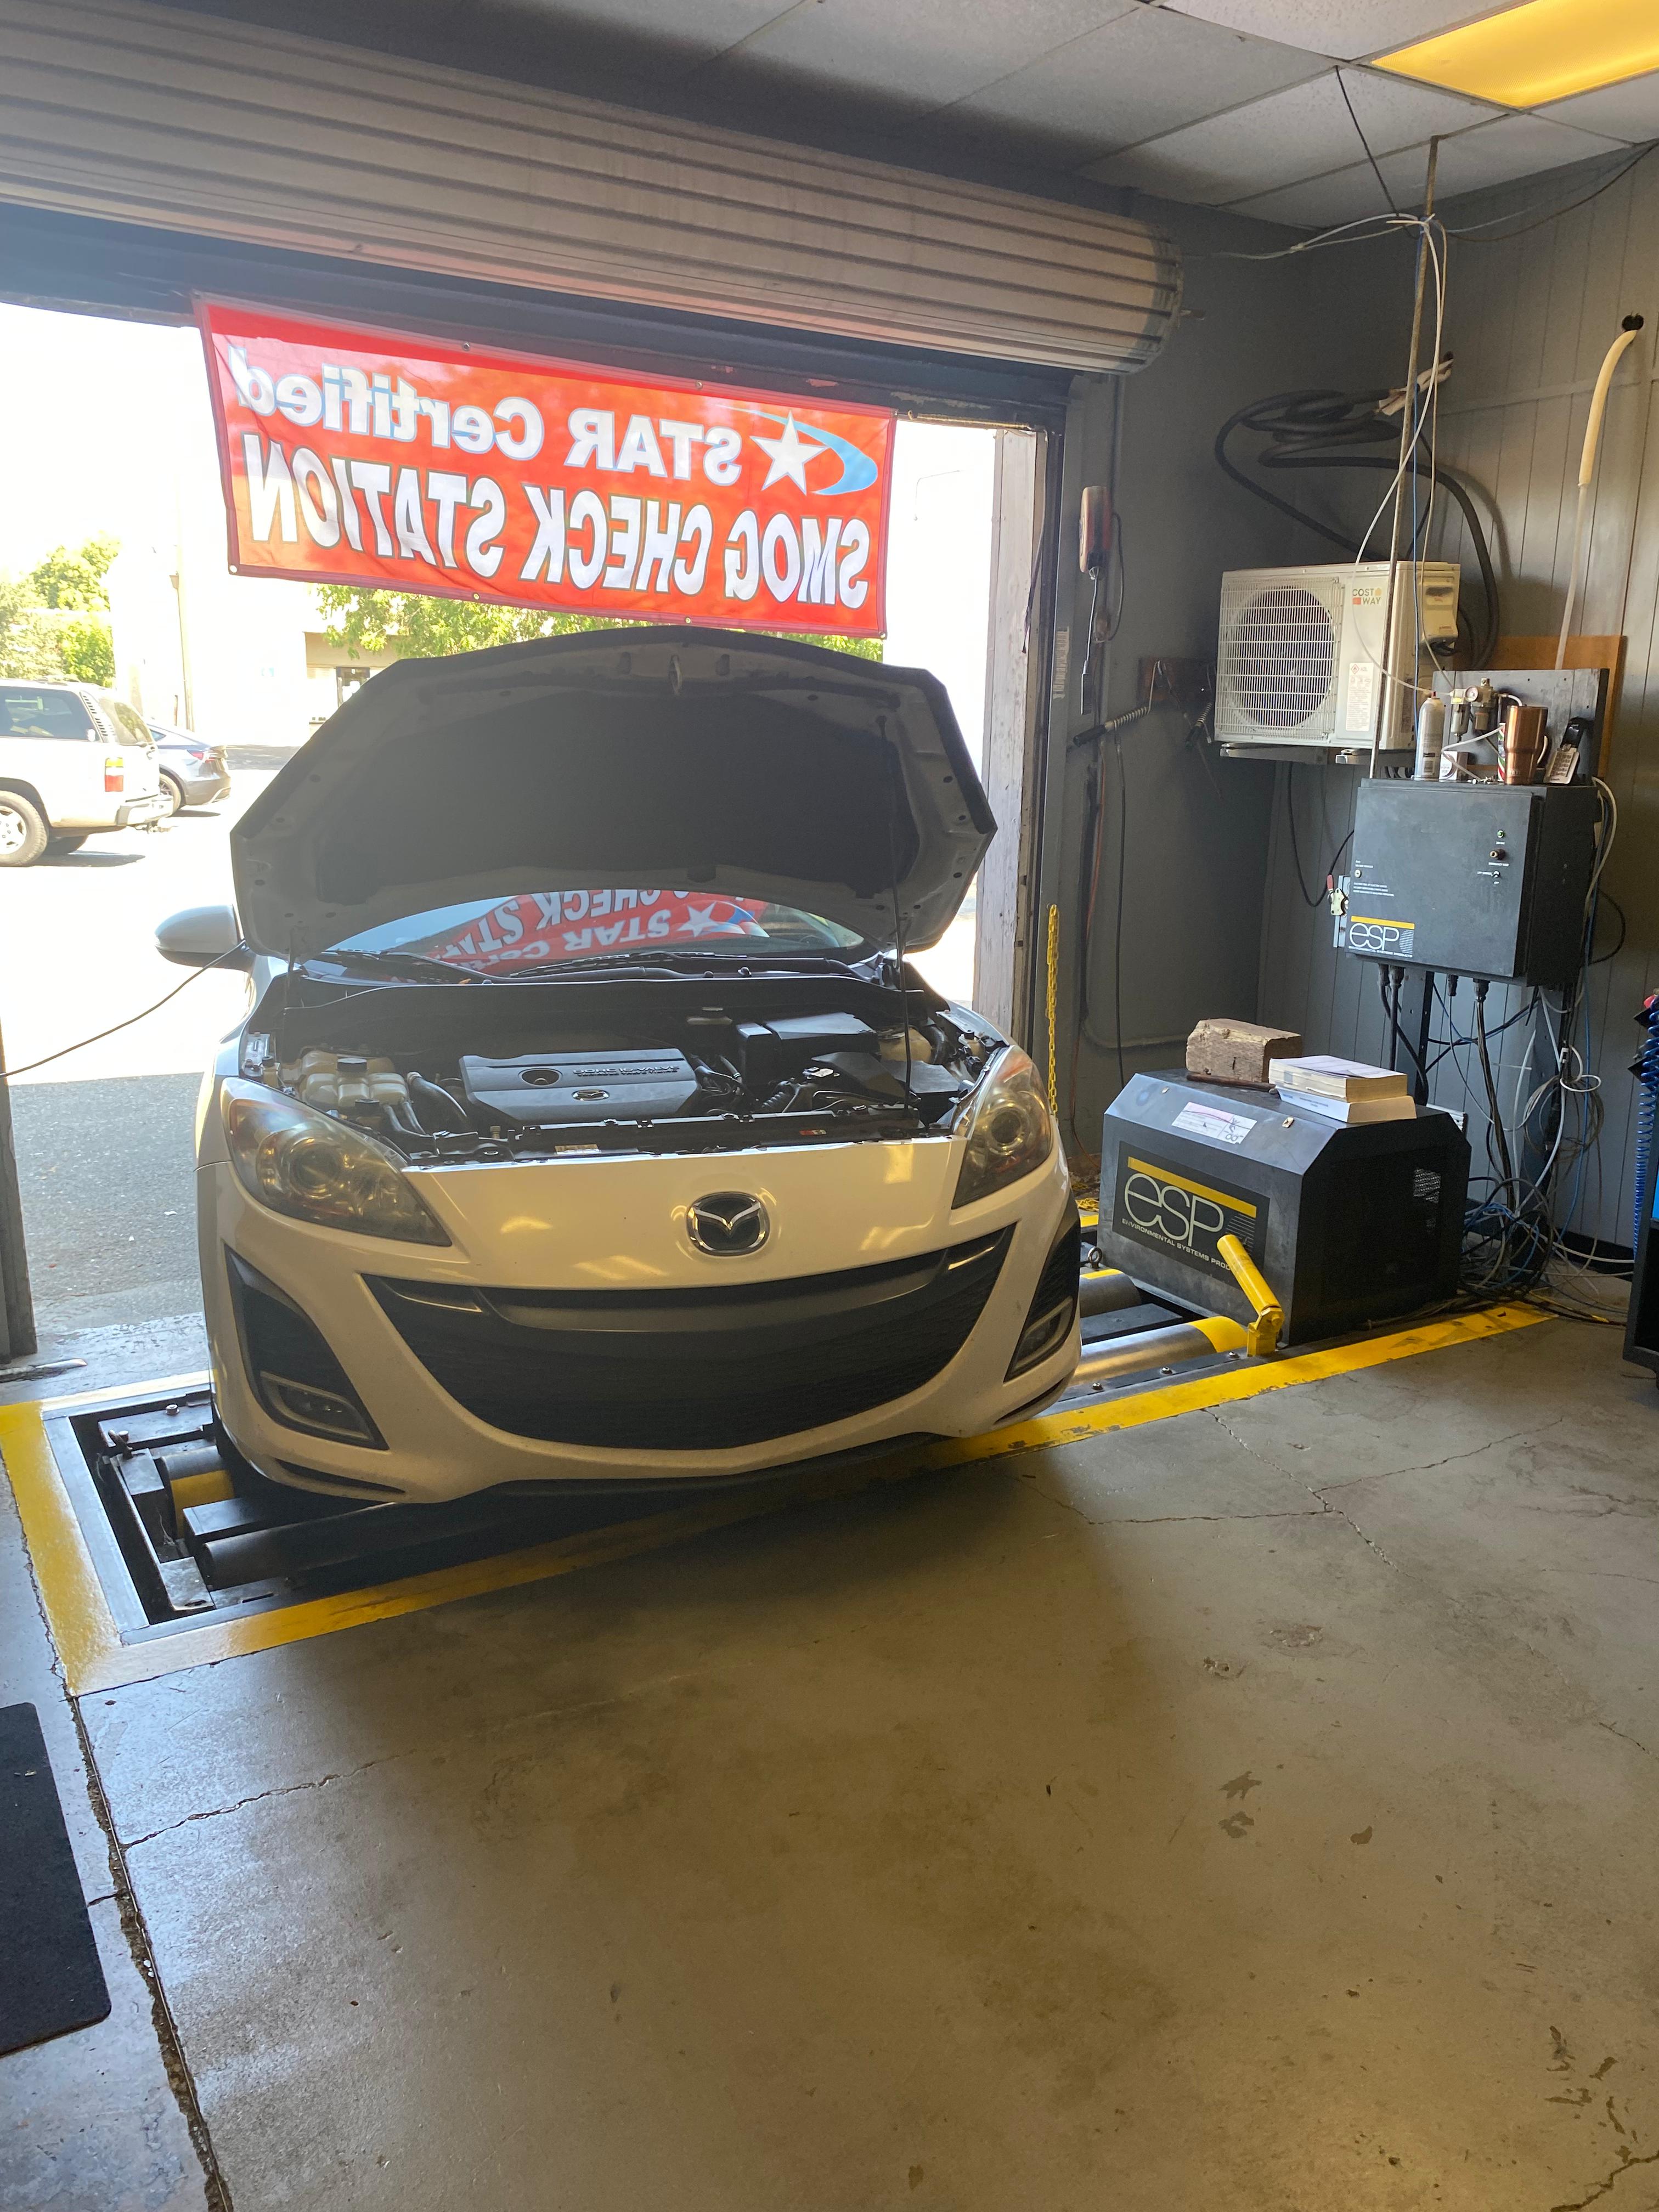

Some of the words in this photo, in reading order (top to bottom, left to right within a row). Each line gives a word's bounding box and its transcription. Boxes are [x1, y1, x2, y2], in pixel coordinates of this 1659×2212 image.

[1352, 588, 1374, 596] COST
[1121, 1218, 1176, 1246] ENVIRONMENTAL
[1177, 1242, 1209, 1261] SYSTEMS
